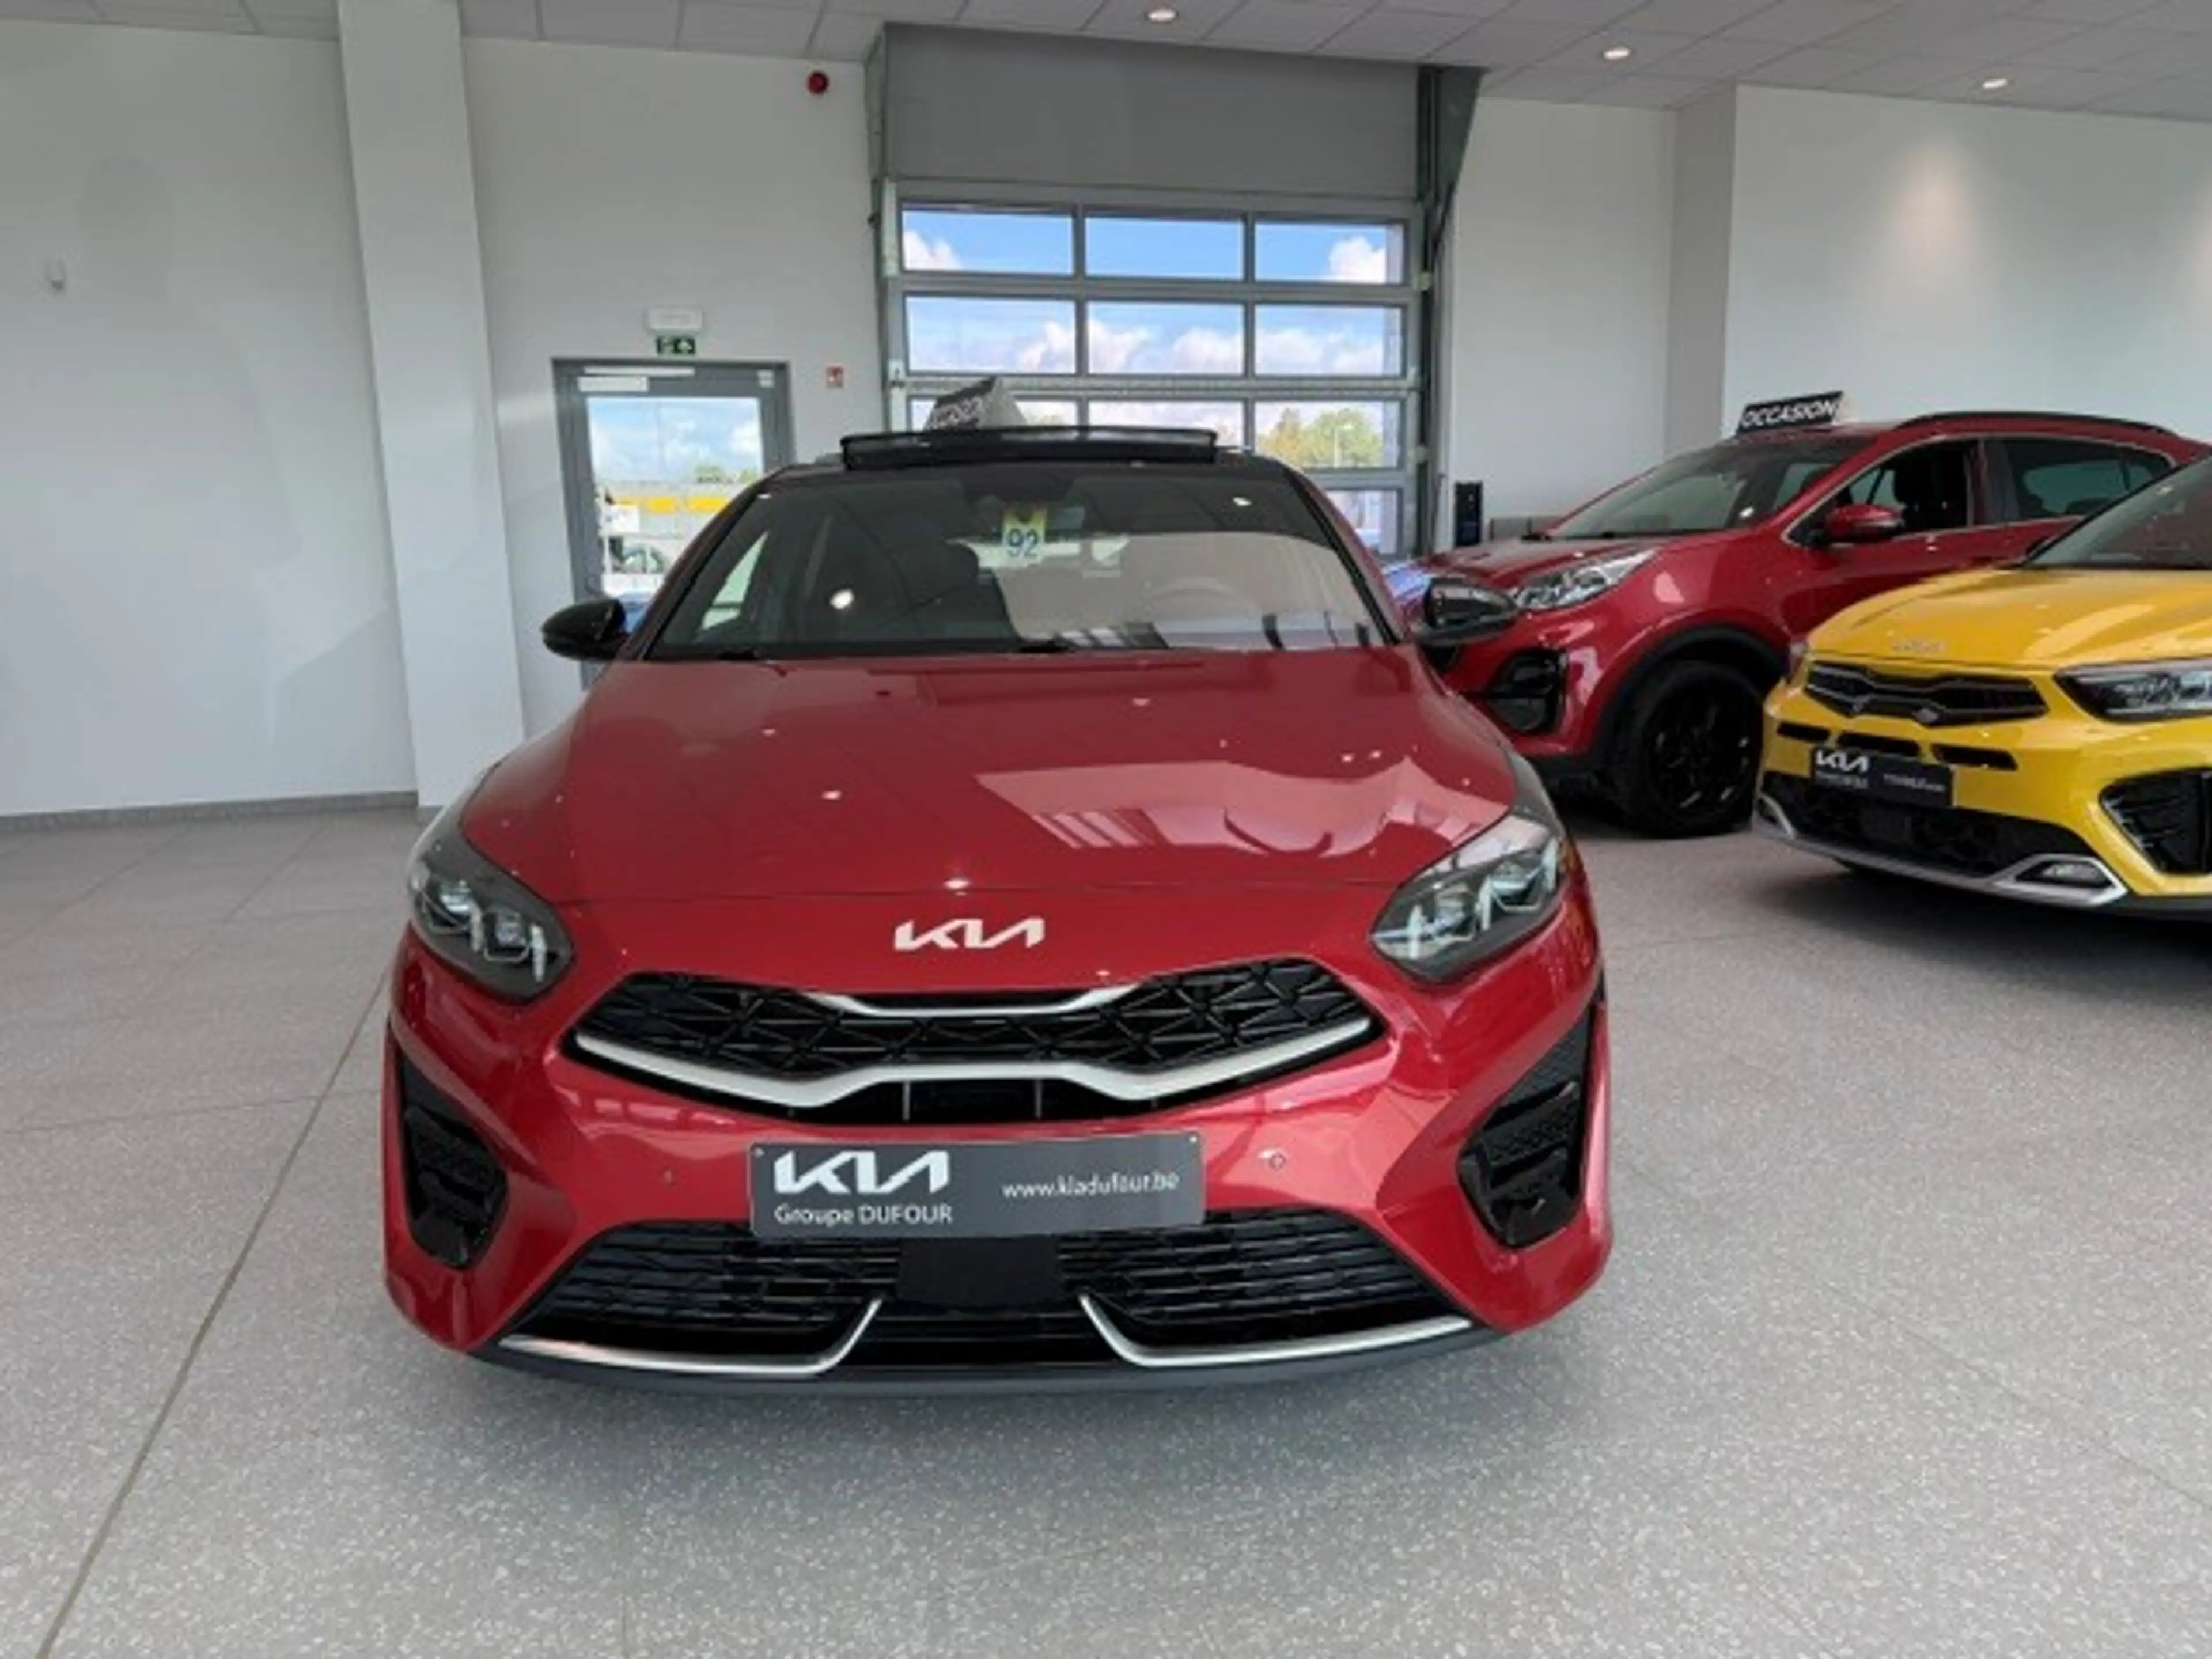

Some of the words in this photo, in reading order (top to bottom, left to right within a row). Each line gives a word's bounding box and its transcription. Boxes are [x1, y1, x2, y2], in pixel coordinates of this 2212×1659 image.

[1007, 528, 1039, 558] 92
[1816, 750, 1869, 774] KIA
[895, 918, 1045, 950] KIA
[774, 1151, 949, 1194] KIA
[774, 1203, 854, 1228] Groupe
[858, 1203, 953, 1225] DUFOUR
